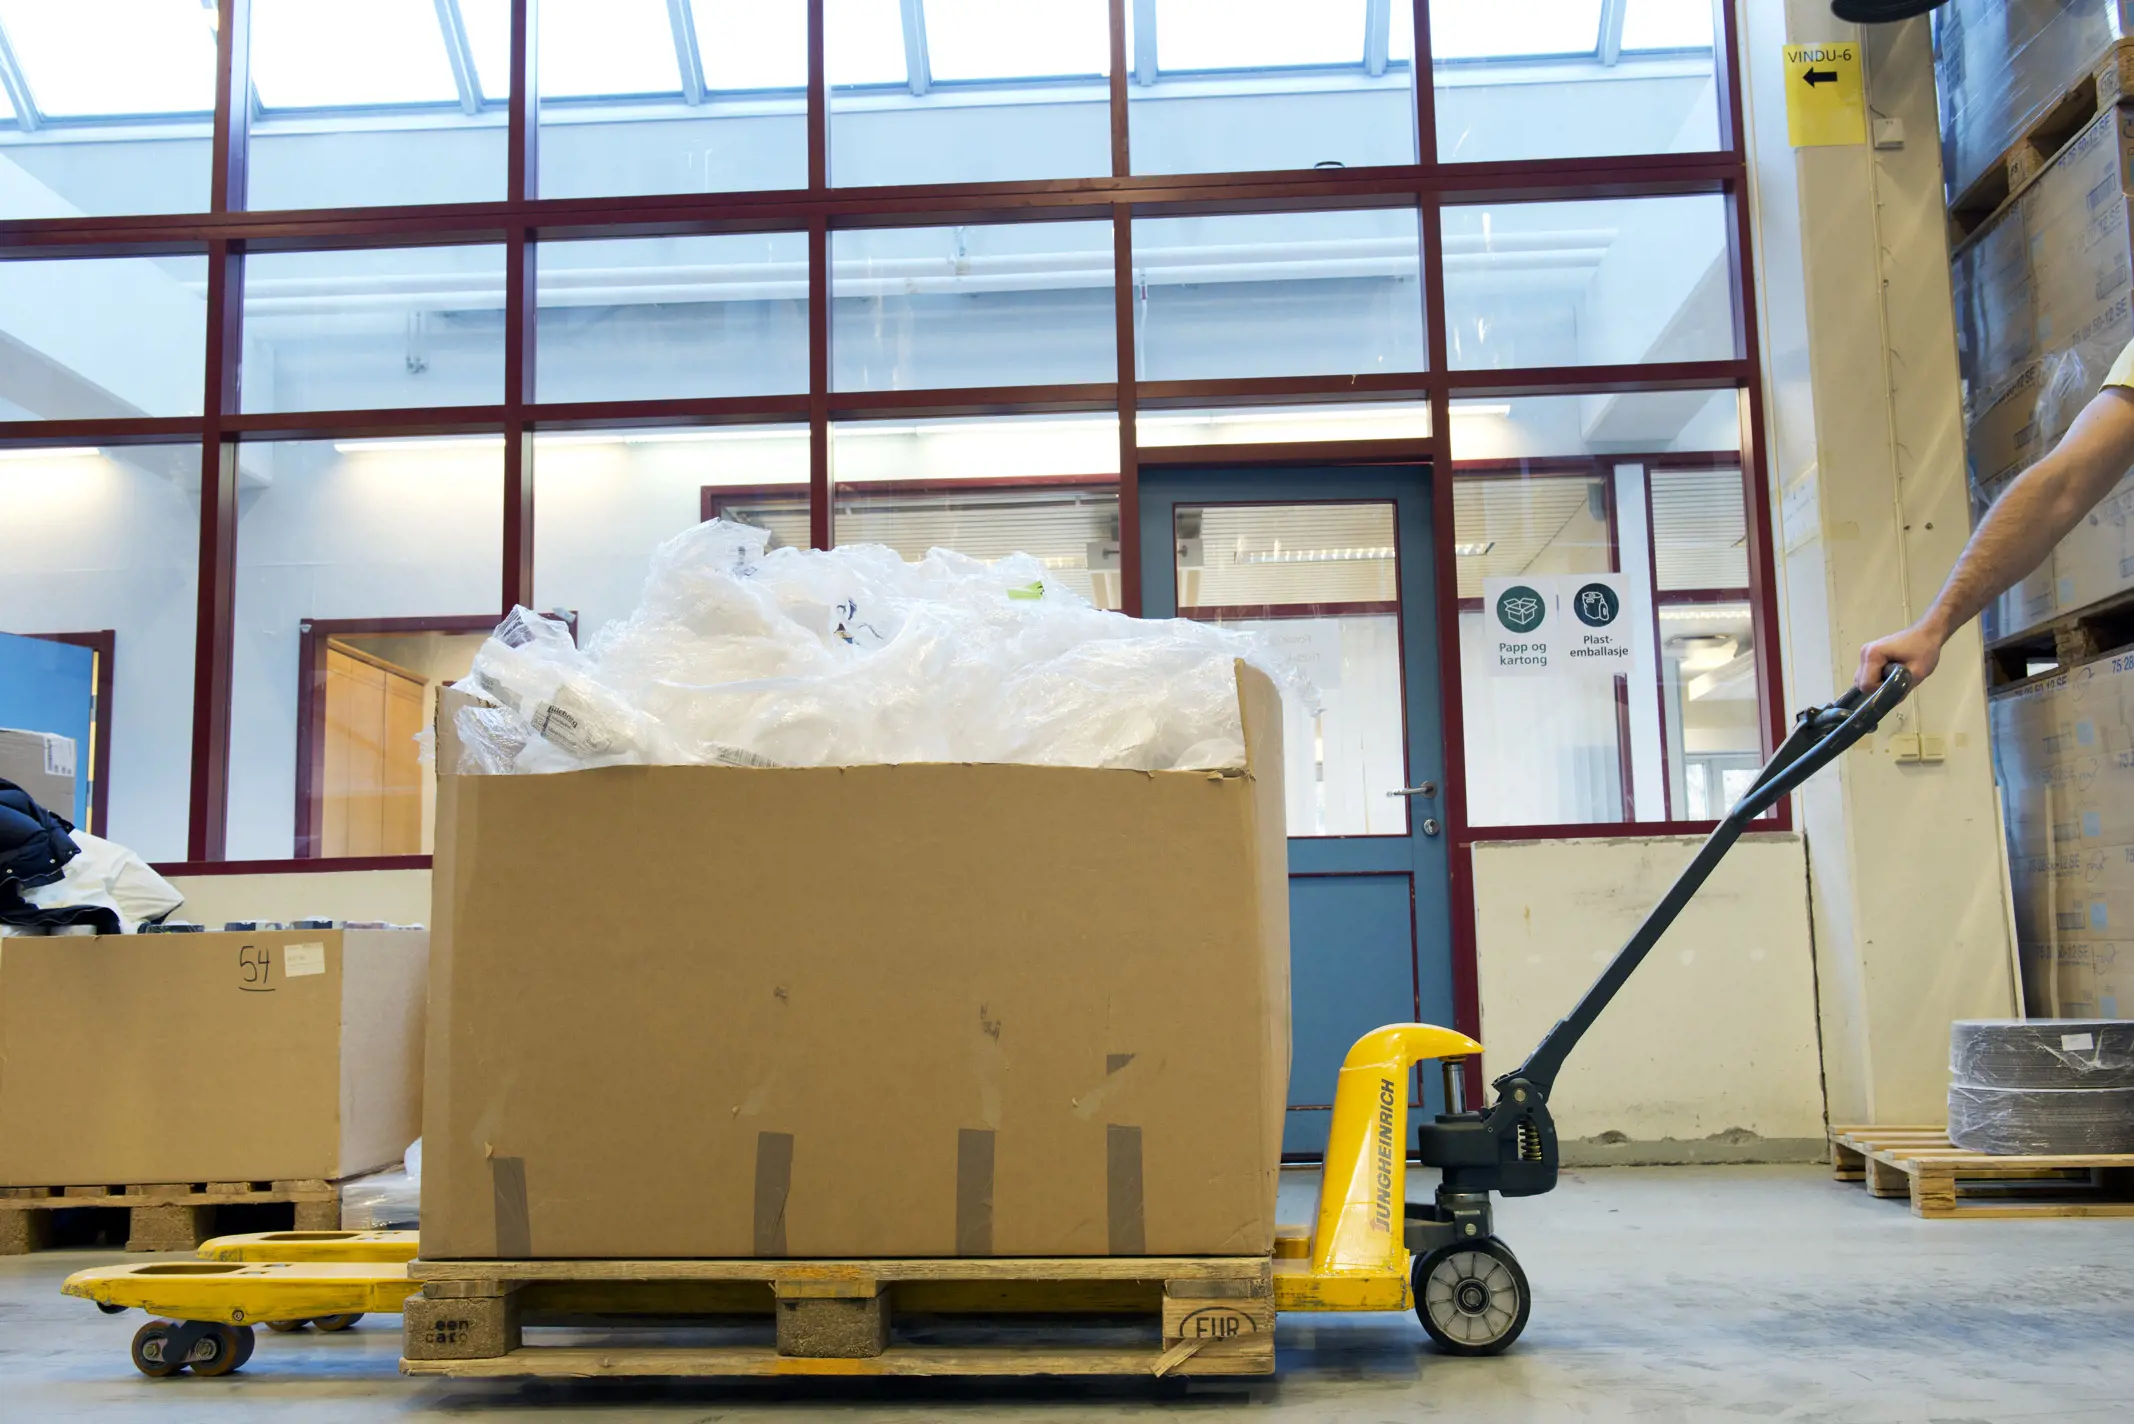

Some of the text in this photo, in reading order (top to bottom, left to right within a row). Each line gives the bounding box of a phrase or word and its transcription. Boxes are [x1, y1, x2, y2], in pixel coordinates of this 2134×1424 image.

[1788, 48, 1852, 63] VINDU-6
[1583, 635, 1613, 644] Plast-
[1499, 642, 1547, 654] Papp og
[1569, 646, 1629, 658] emballasje
[1500, 655, 1547, 667] kartong
[2111, 659, 2123, 675] 75
[239, 945, 271, 984] 54
[1375, 1079, 1395, 1233] JUNGHEINRICH
[1196, 1316, 1240, 1338] EUR
